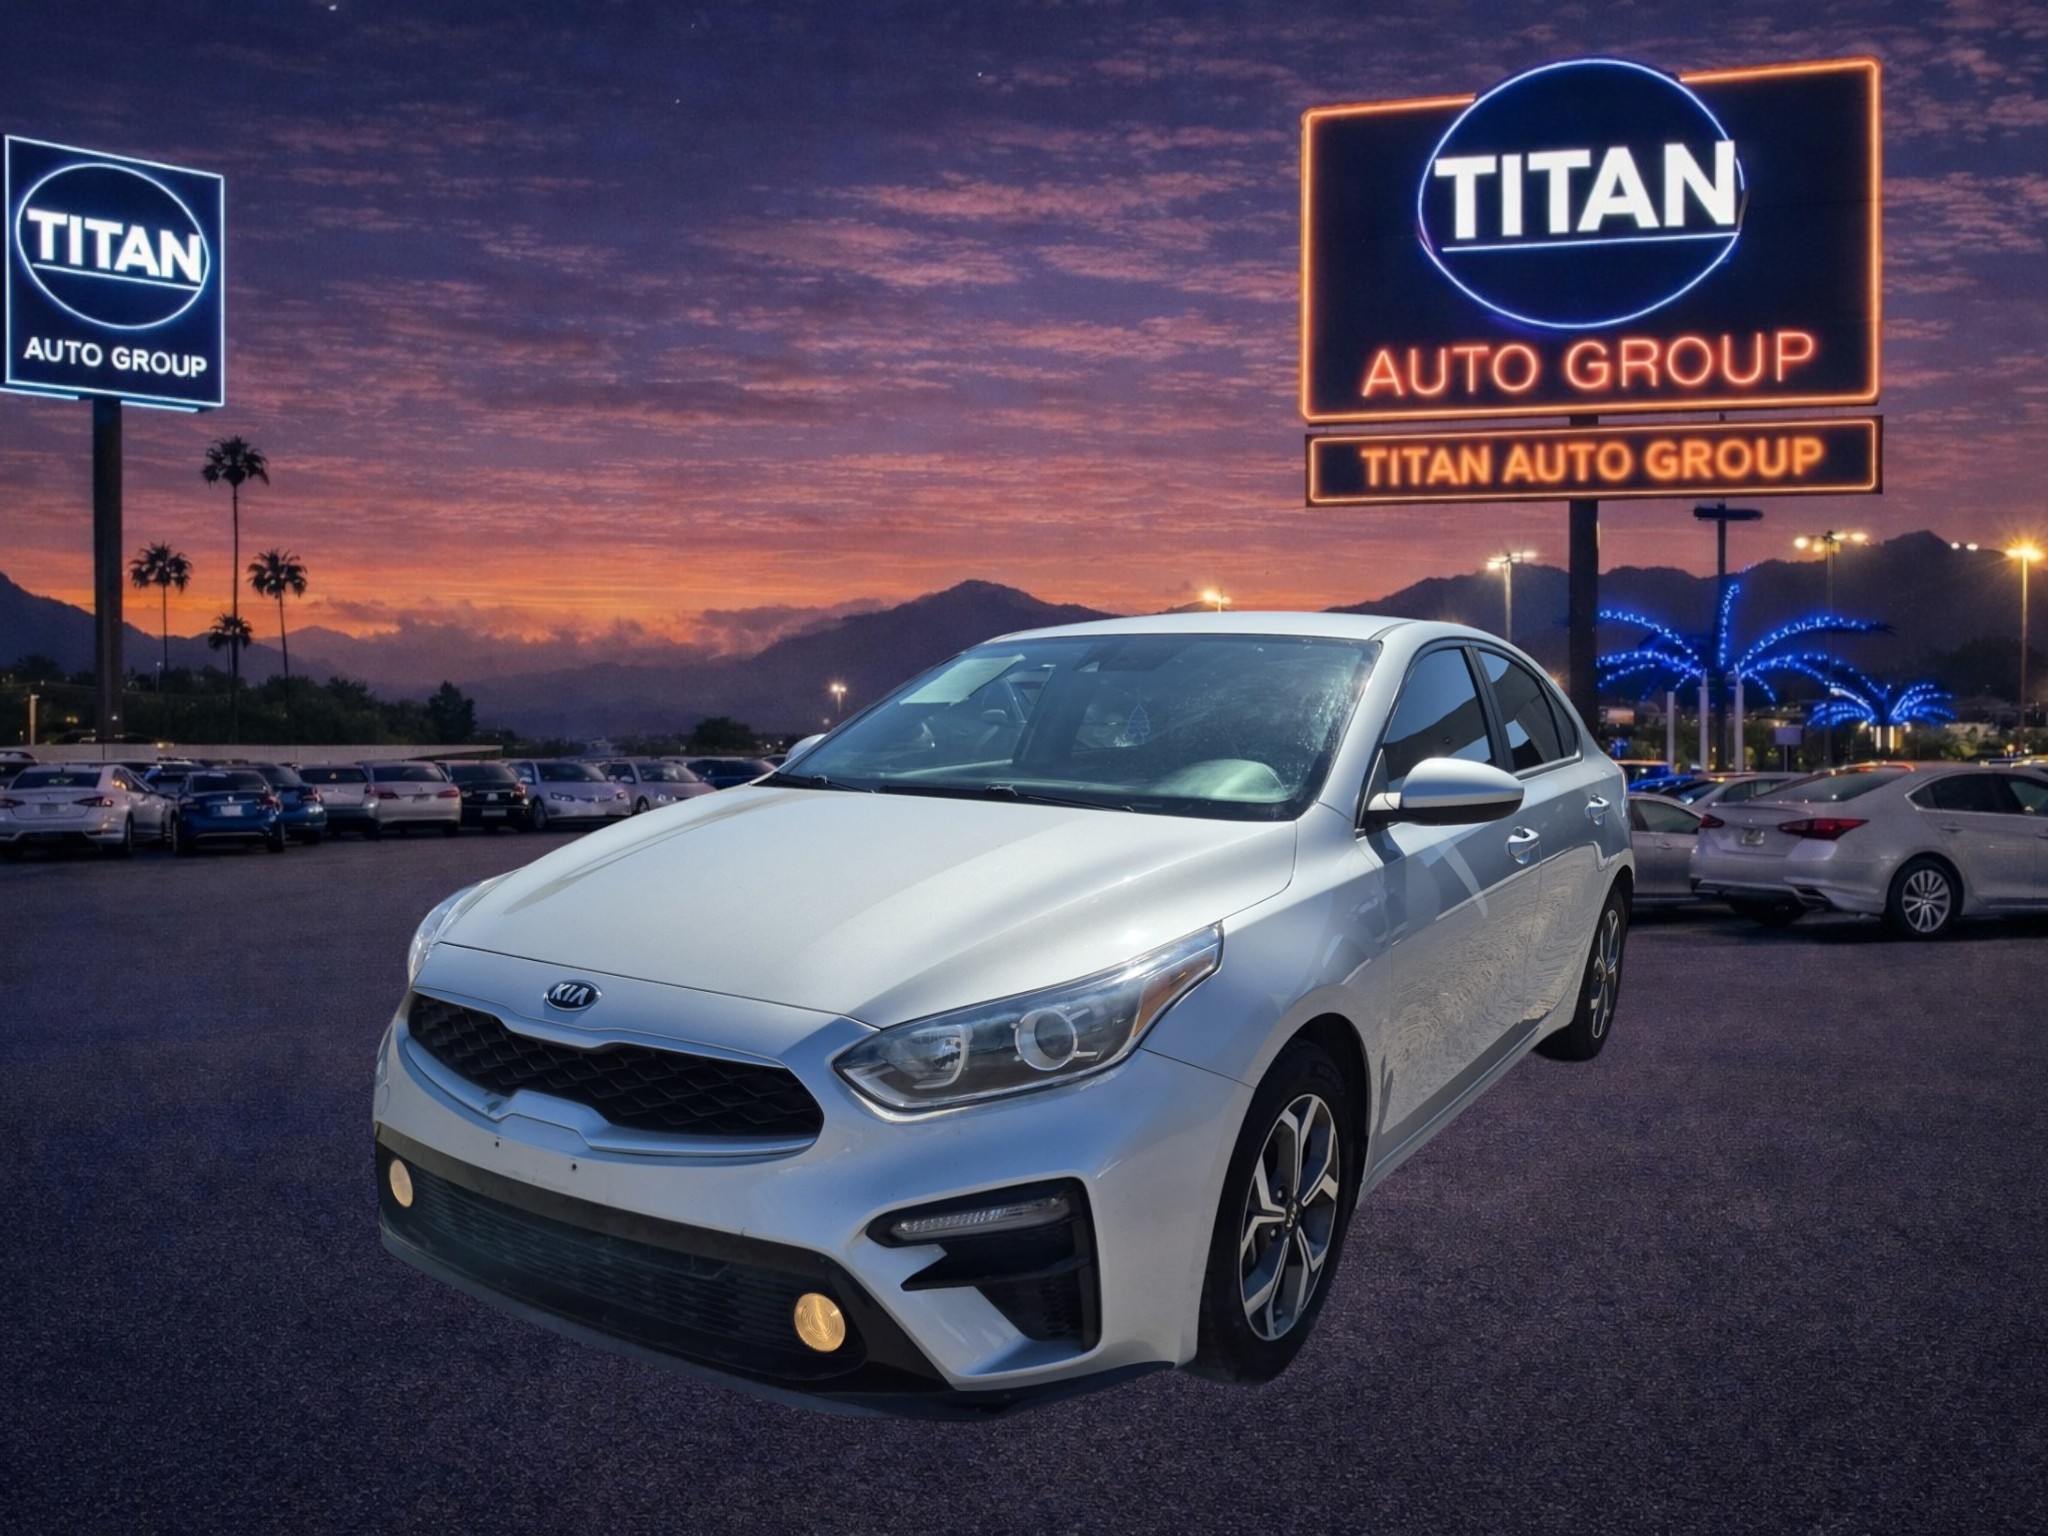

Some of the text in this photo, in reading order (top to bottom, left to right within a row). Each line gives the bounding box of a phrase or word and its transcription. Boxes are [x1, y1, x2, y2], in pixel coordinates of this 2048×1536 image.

[1434, 139, 1736, 240] TITAN
[27, 207, 201, 283] TITAN
[23, 336, 207, 377] AUTO GROUP
[1361, 331, 1816, 397] AUTO GROUP
[1361, 437, 1825, 487] TITAN AUTO GROUP
[550, 983, 589, 1005] KIA
